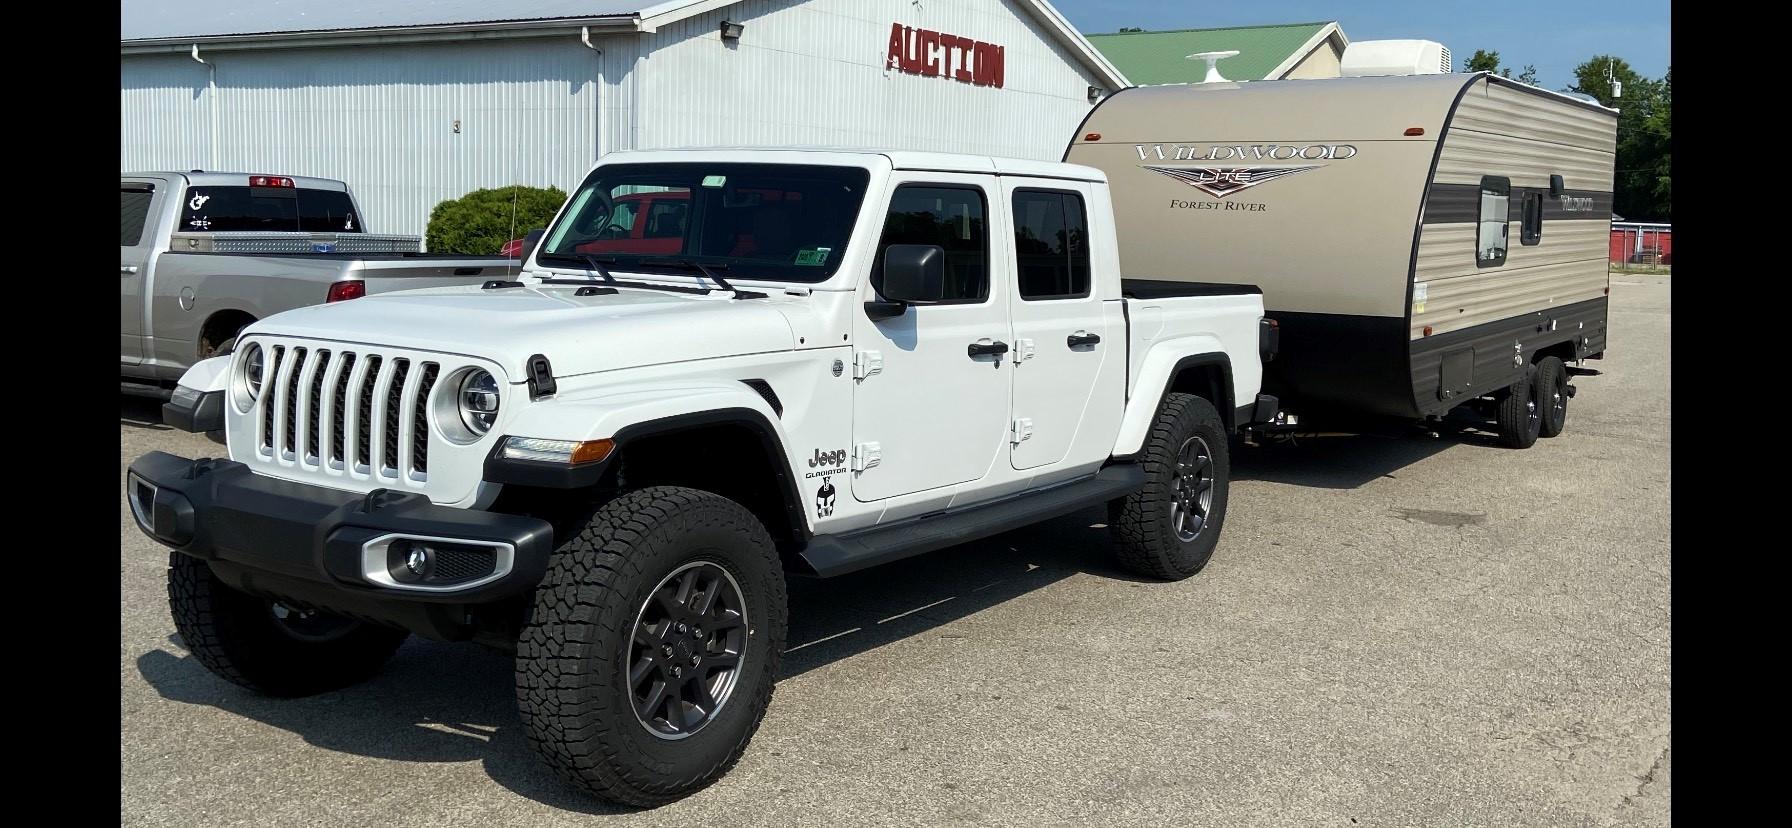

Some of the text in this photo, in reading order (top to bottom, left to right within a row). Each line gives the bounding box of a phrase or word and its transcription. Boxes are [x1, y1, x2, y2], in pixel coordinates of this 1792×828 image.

[886, 22, 1005, 89] AUCTION
[1135, 144, 1358, 161] WILDWOOD
[1200, 171, 1252, 181] LITE
[1169, 199, 1267, 212] FOREST RIVER
[808, 448, 847, 468] Jeep
[805, 467, 847, 479] GLADIATOR
